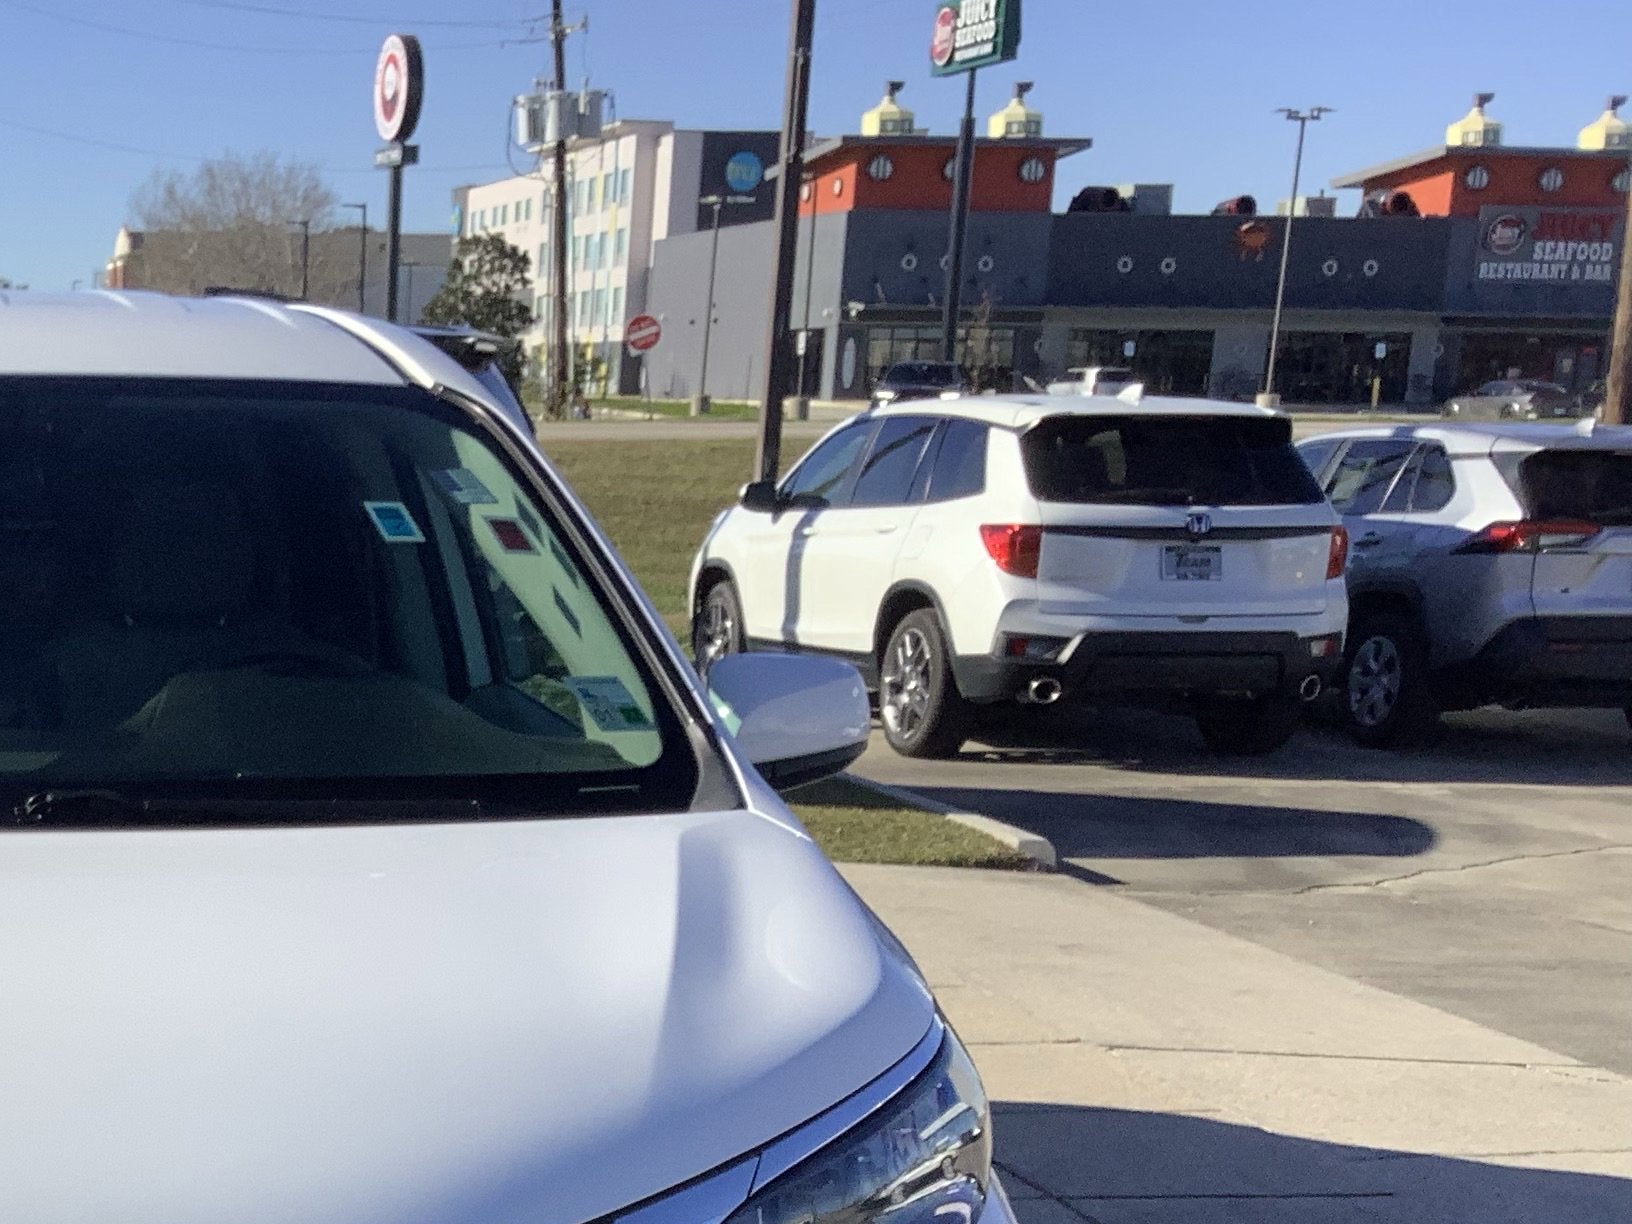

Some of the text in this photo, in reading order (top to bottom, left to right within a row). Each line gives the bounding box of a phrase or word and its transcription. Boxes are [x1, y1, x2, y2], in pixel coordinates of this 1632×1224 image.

[1532, 240, 1614, 261] SEAFOOD
[1478, 262, 1568, 280] RESTAURANT
[1584, 263, 1613, 281] BAR
